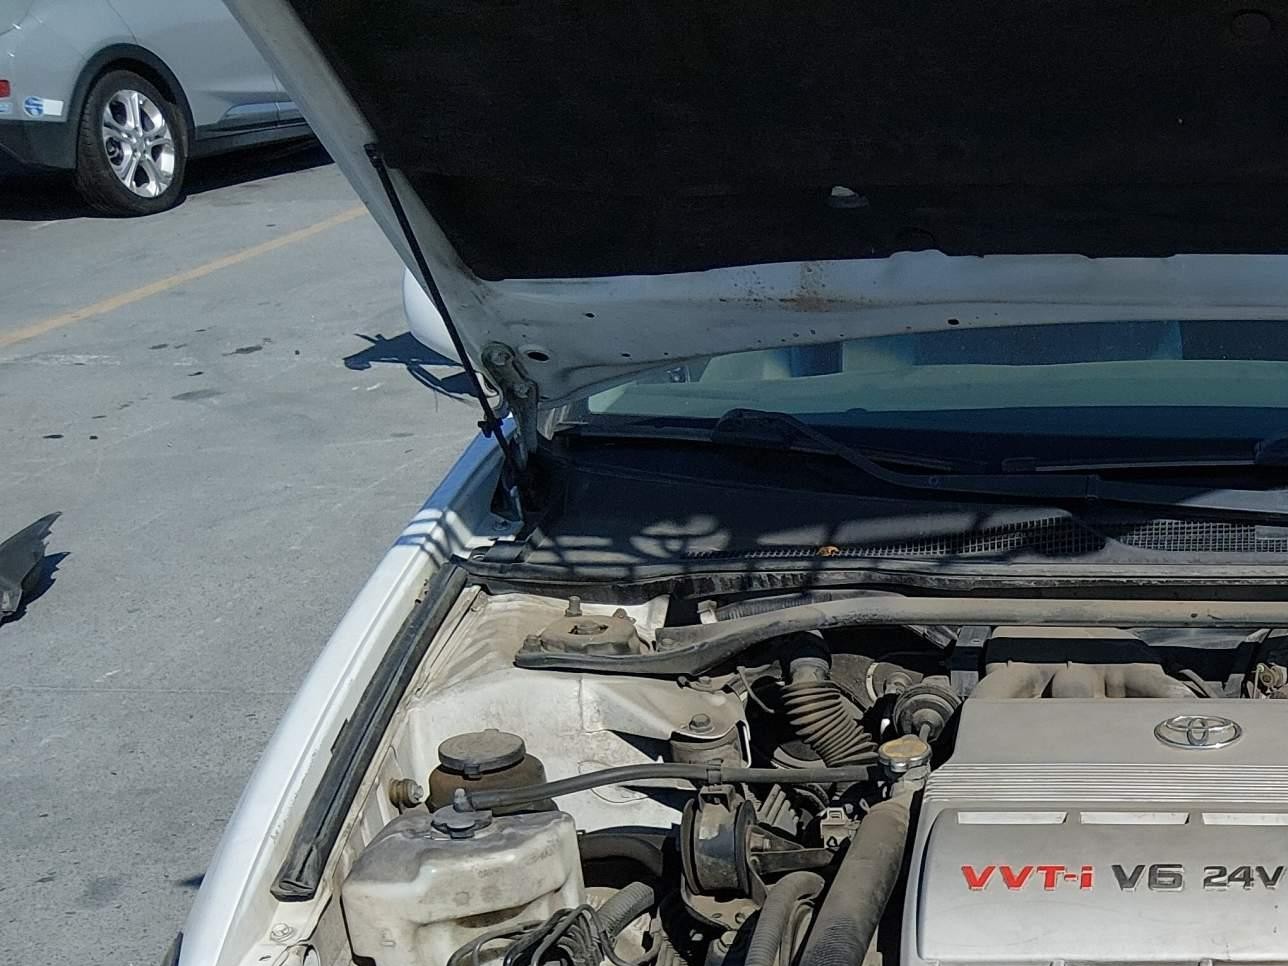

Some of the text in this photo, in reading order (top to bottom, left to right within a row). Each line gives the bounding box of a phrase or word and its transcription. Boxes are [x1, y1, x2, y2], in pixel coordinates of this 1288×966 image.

[962, 864, 1288, 891] VVT-i V6 24V
